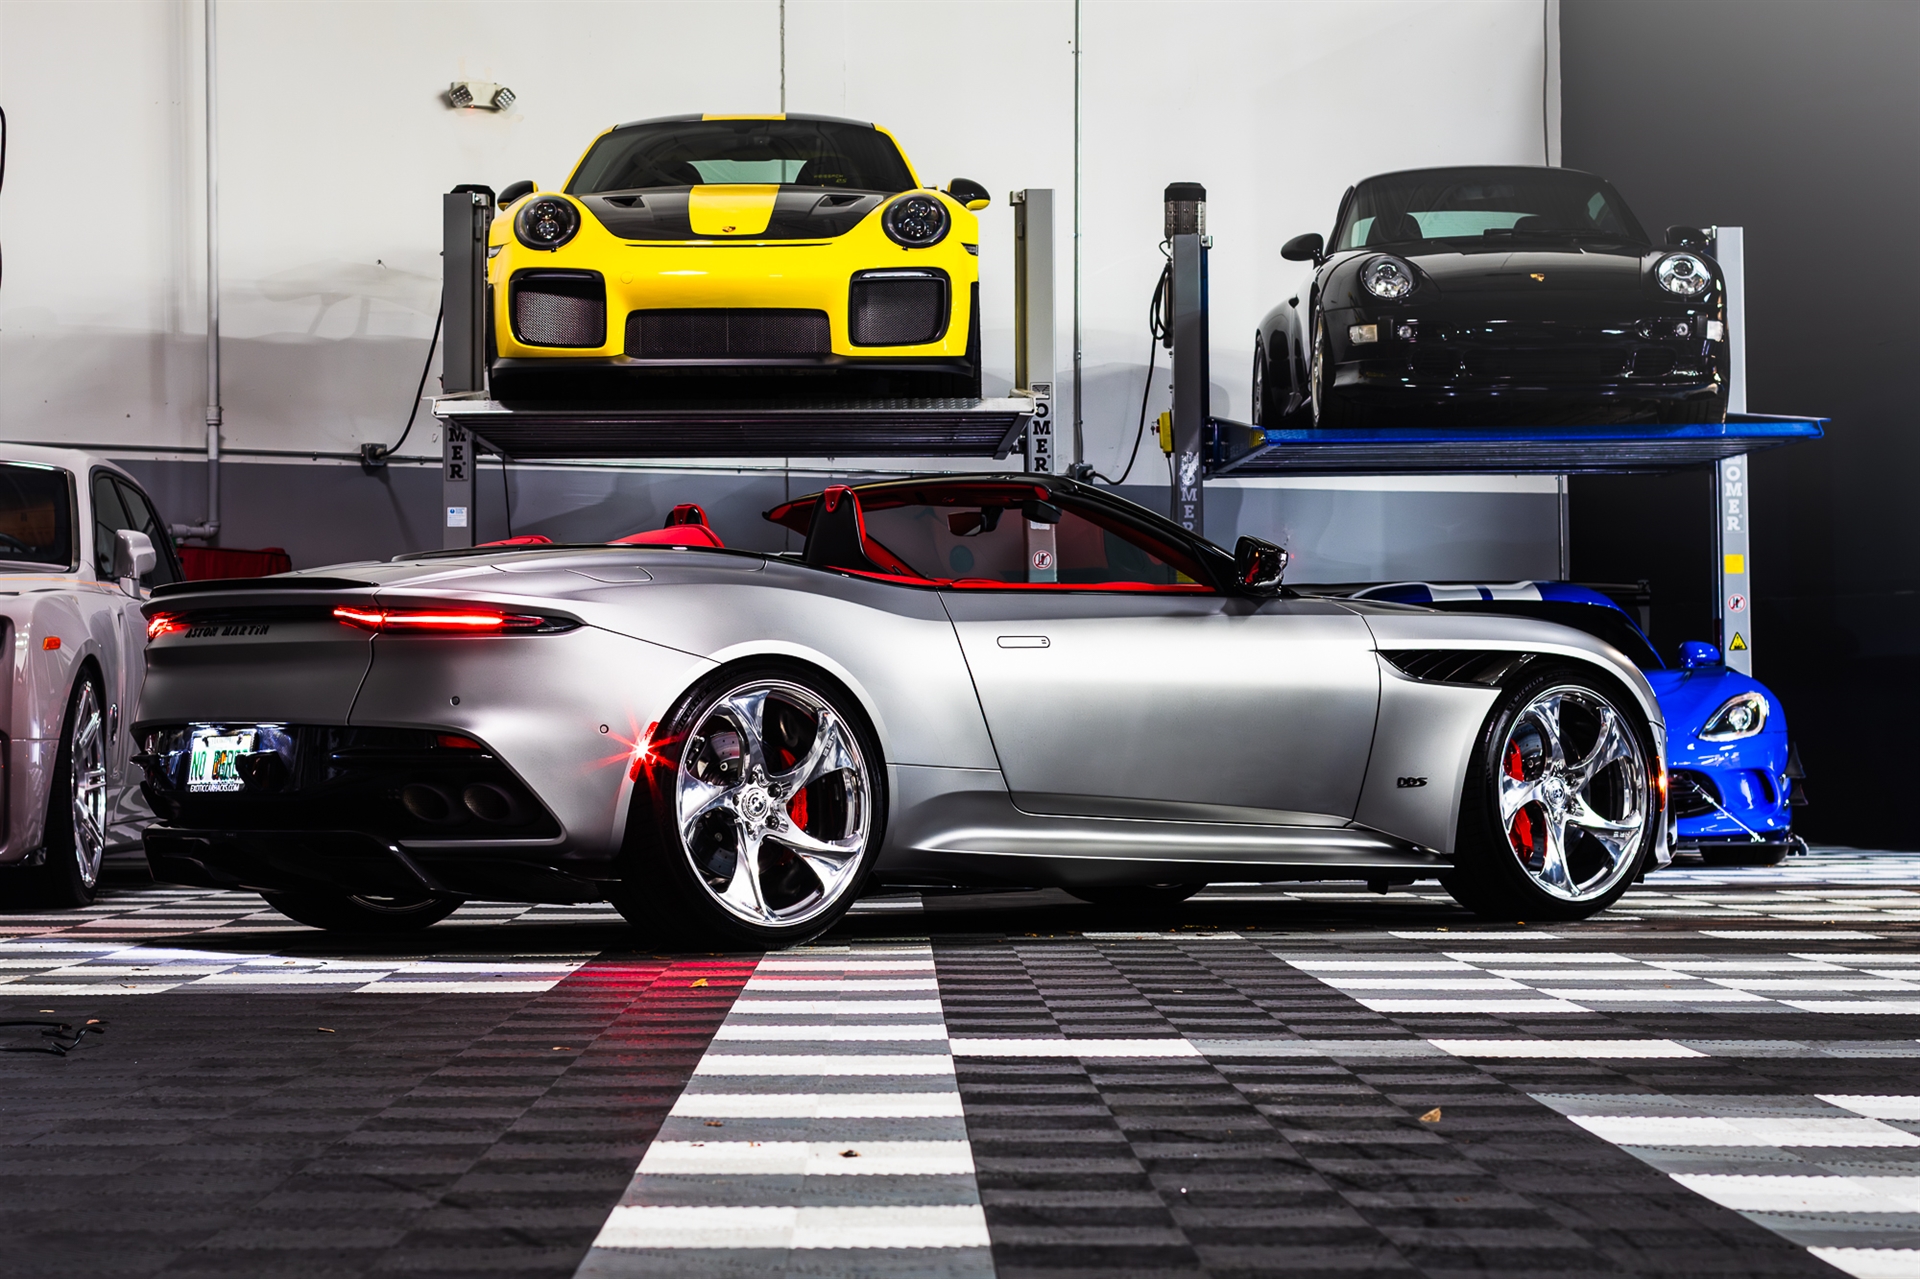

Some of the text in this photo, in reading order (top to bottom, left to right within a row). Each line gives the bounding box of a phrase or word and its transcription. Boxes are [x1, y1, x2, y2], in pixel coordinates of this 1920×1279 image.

[447, 427, 467, 479] MER
[1033, 402, 1051, 472] OMER
[1725, 465, 1743, 531] OMER
[185, 625, 270, 639] ASTON MARTIN
[190, 750, 207, 781] NO
[1397, 776, 1428, 788] DBS
